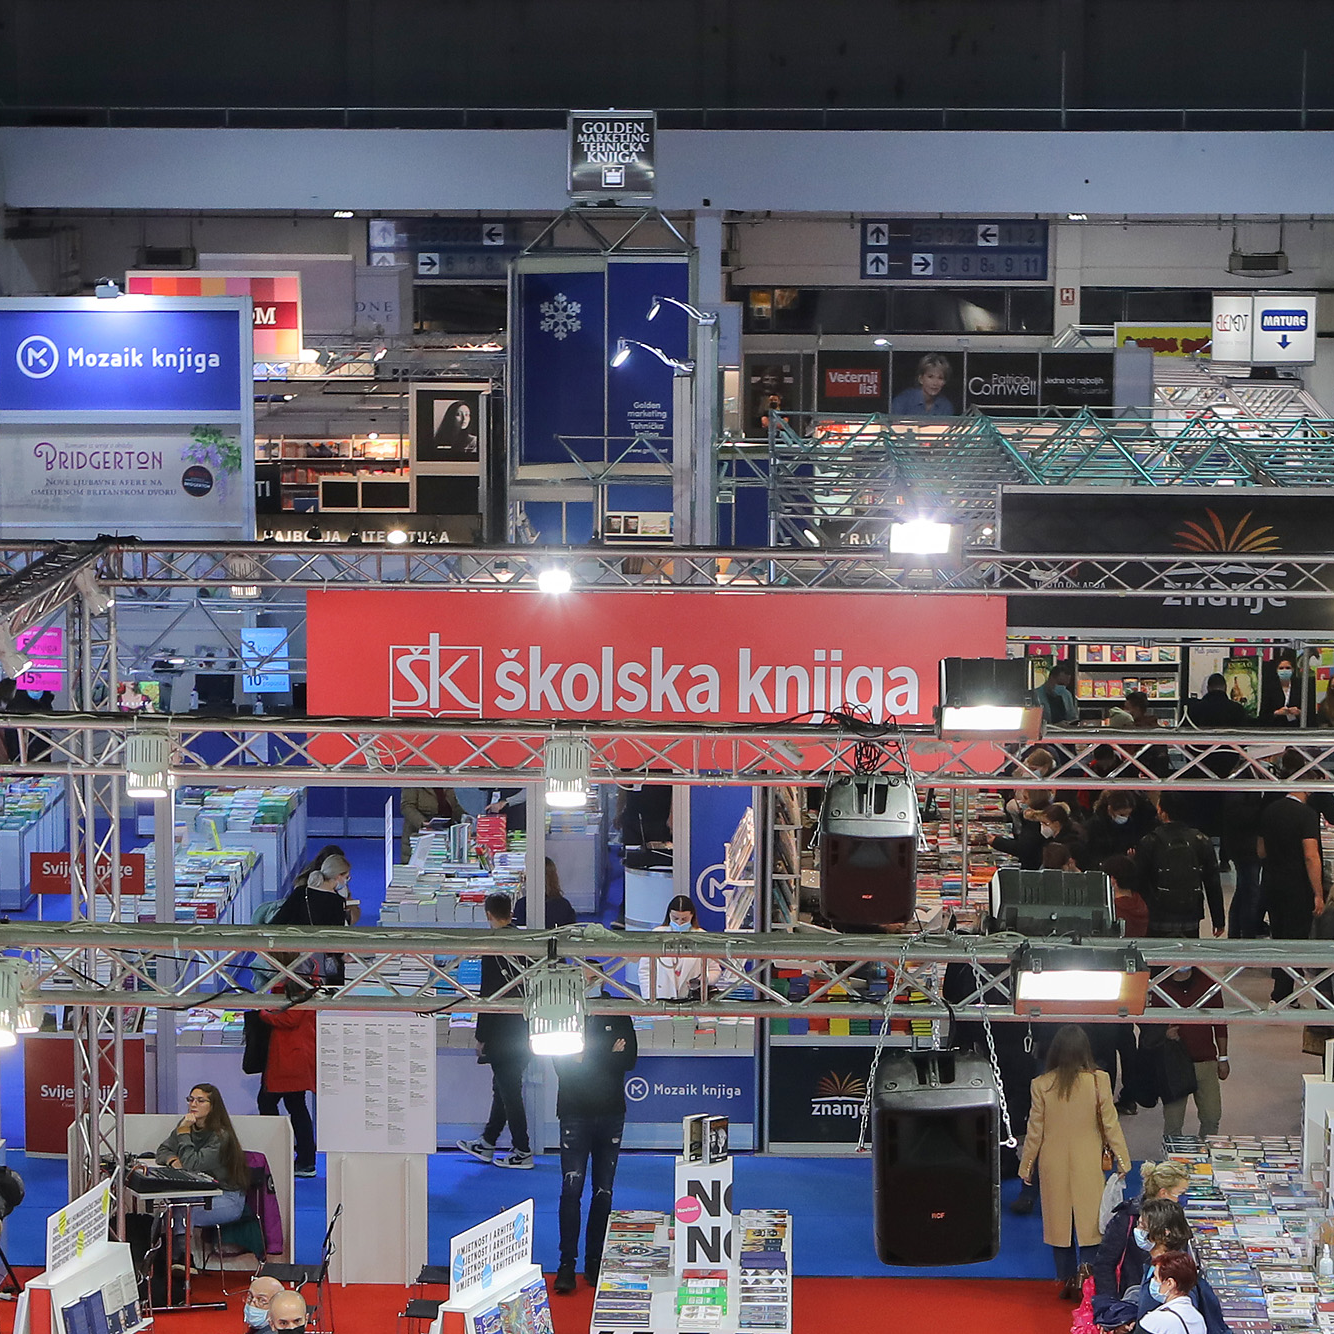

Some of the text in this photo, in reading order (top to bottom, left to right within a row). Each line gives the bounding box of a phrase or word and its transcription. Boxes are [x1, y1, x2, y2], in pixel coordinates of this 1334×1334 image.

[581, 122, 645, 134] GOLDEN
[576, 133, 650, 143] MARKETING
[581, 141, 645, 152] TEHNIČKA
[586, 151, 640, 163] KNJIGA
[939, 256, 949, 273] 6
[961, 256, 970, 273] 8
[1004, 256, 1014, 273] 9
[1023, 256, 1039, 273] 11
[1262, 315, 1307, 327] MATURE
[67, 347, 221, 374] Mozaik knjiga
[828, 370, 878, 384] Večernji
[991, 373, 1031, 386] Patricia
[1044, 376, 1104, 387] Jedna od najboljih
[858, 382, 878, 395] list
[968, 376, 1037, 396] Cornwell
[633, 401, 661, 409] Golden
[627, 410, 667, 419] marketing
[630, 421, 664, 430] Tehnička
[33, 442, 163, 471] BRIDGERTON
[247, 640, 255, 653] 3
[494, 645, 921, 725] školska knjiga
[653, 1083, 742, 1099] Mozaik knjiga
[493, 1237, 529, 1263] ARHITEKTURA
[492, 1249, 529, 1274] ARHITEKTURA
